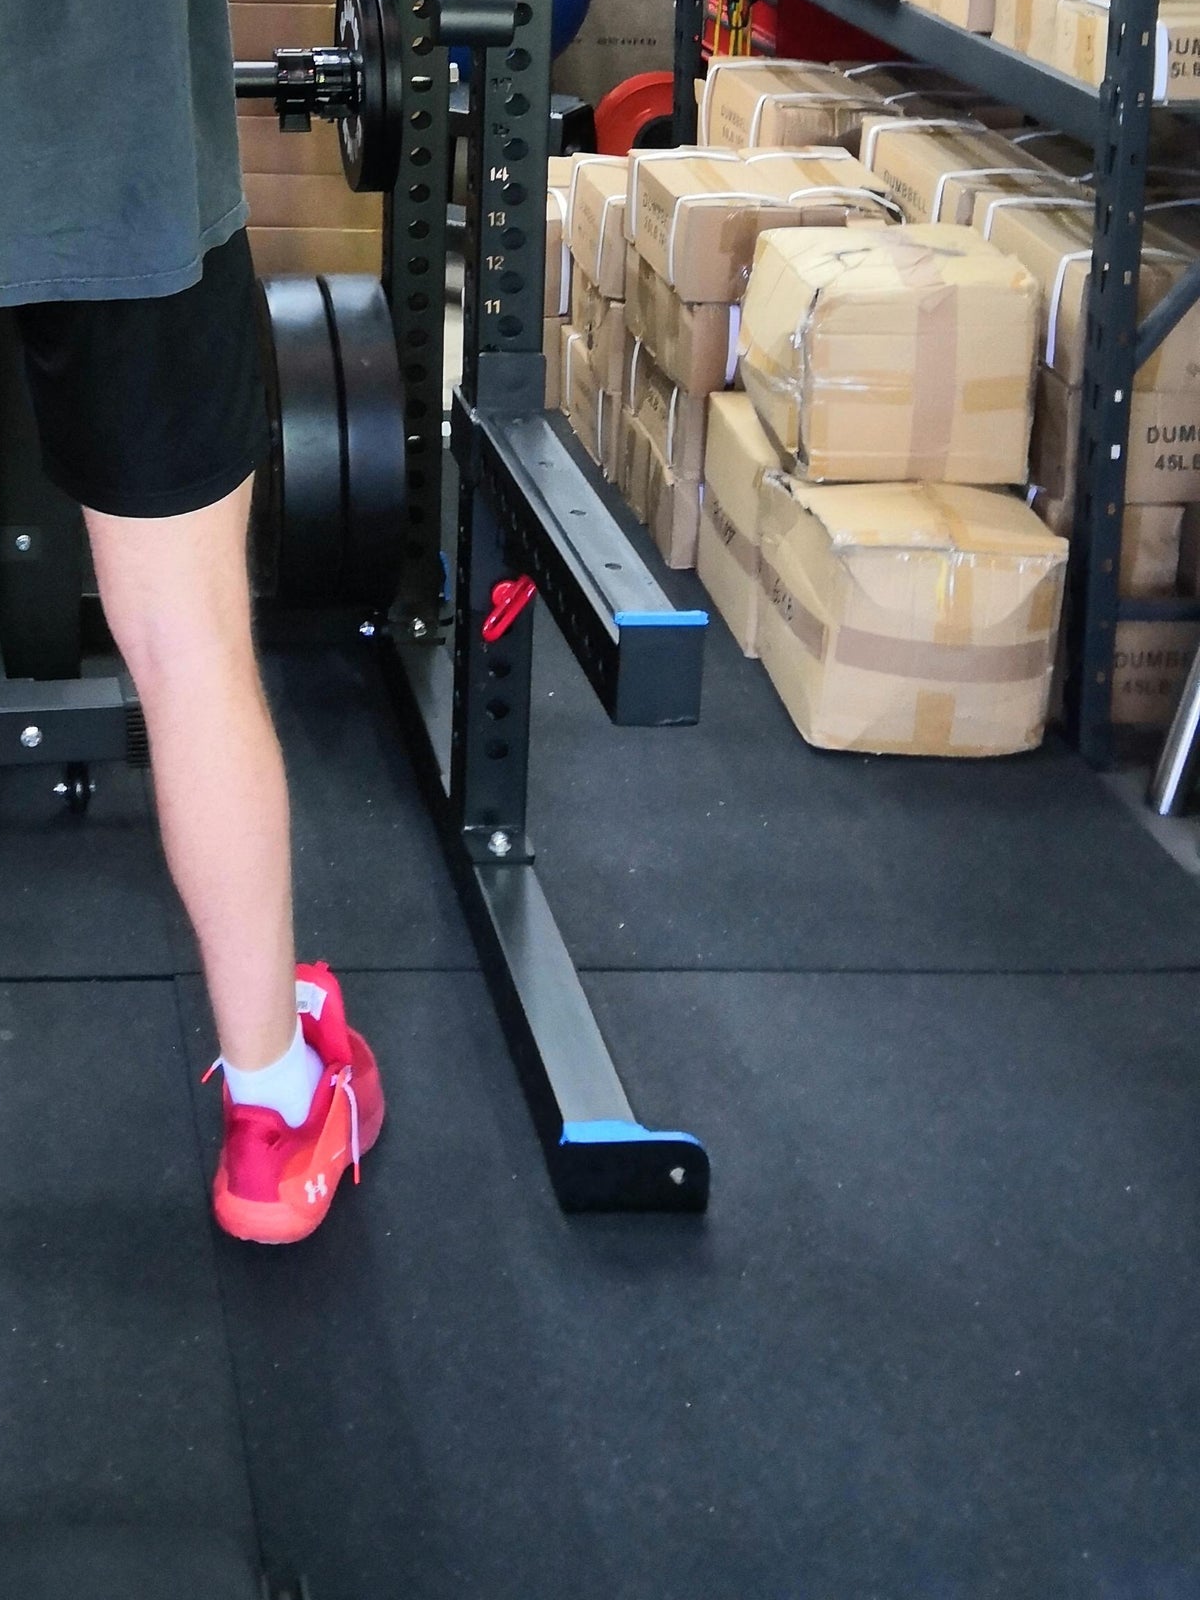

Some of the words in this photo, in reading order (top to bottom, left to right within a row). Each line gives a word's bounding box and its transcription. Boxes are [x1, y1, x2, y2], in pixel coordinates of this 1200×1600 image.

[487, 211, 506, 227] 13
[486, 255, 505, 271] 12
[484, 299, 501, 315] 11
